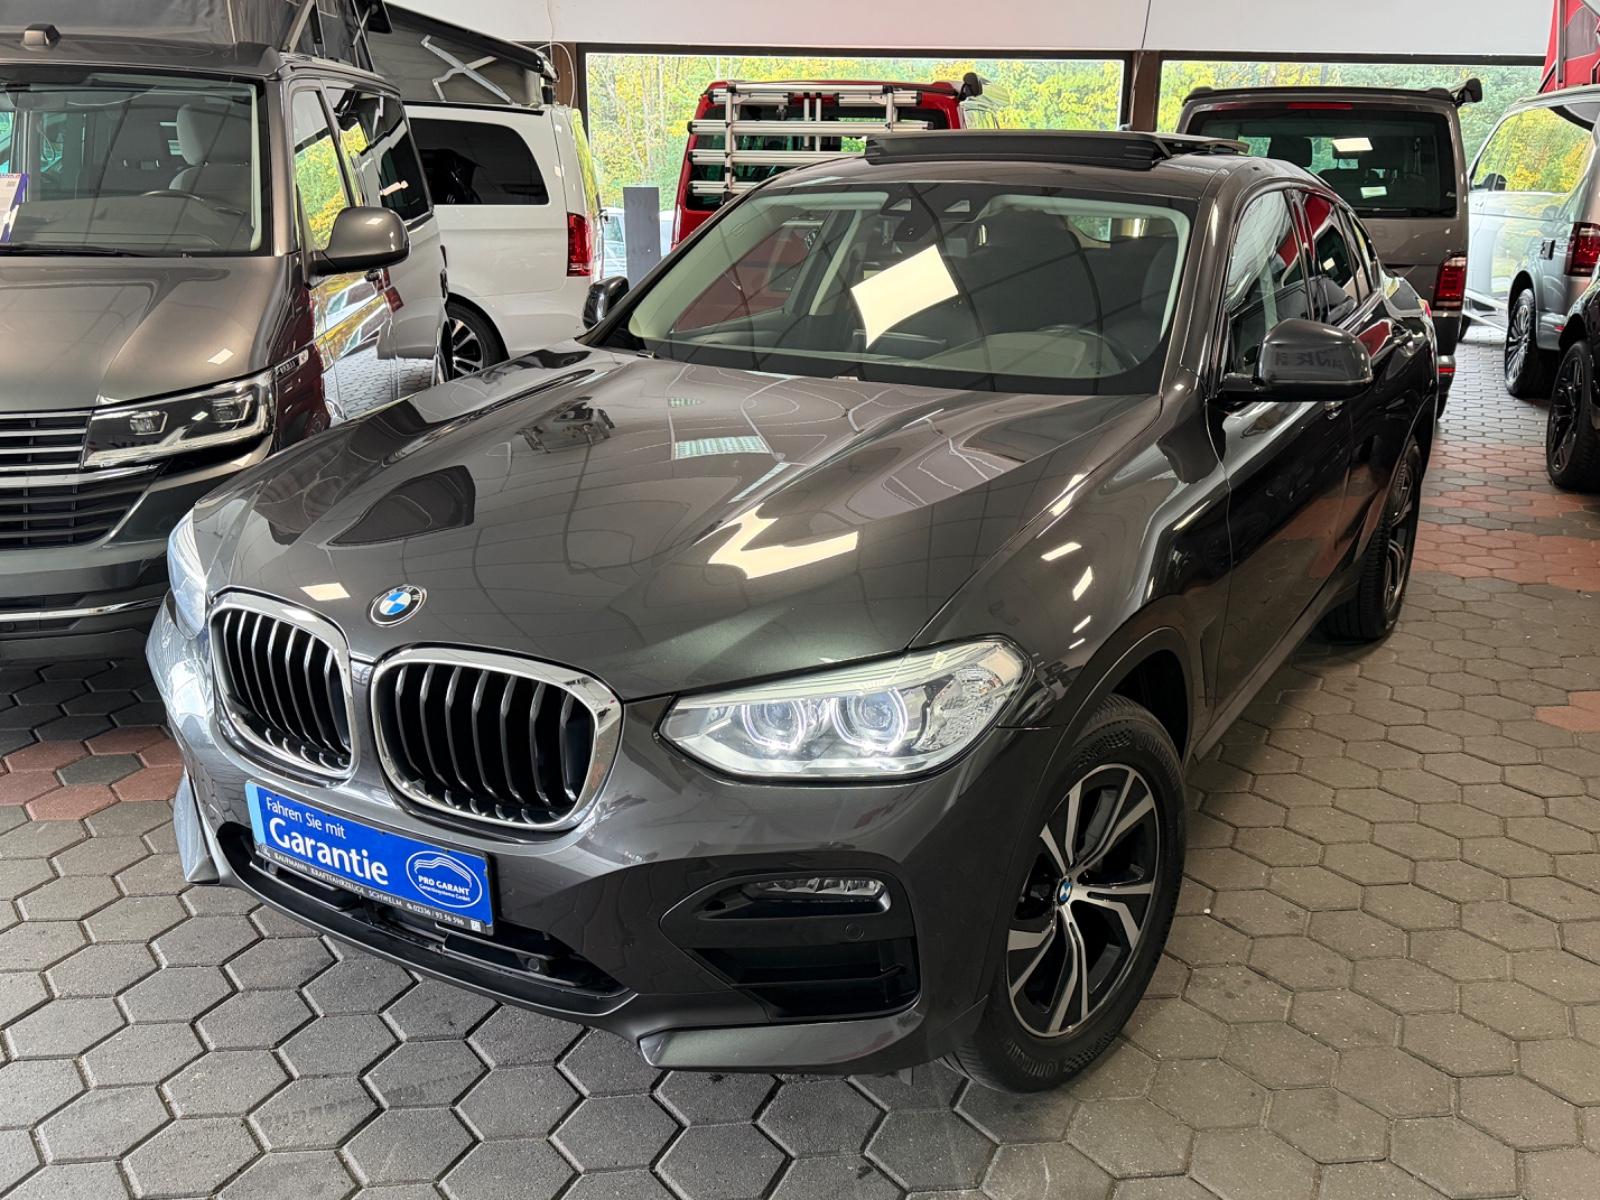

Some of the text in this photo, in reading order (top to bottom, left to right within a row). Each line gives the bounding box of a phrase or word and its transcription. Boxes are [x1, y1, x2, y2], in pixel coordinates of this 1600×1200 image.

[266, 797, 346, 839] Fahren Sie mit
[269, 817, 389, 885] Garantie
[418, 875, 470, 897] PRO GARANT
